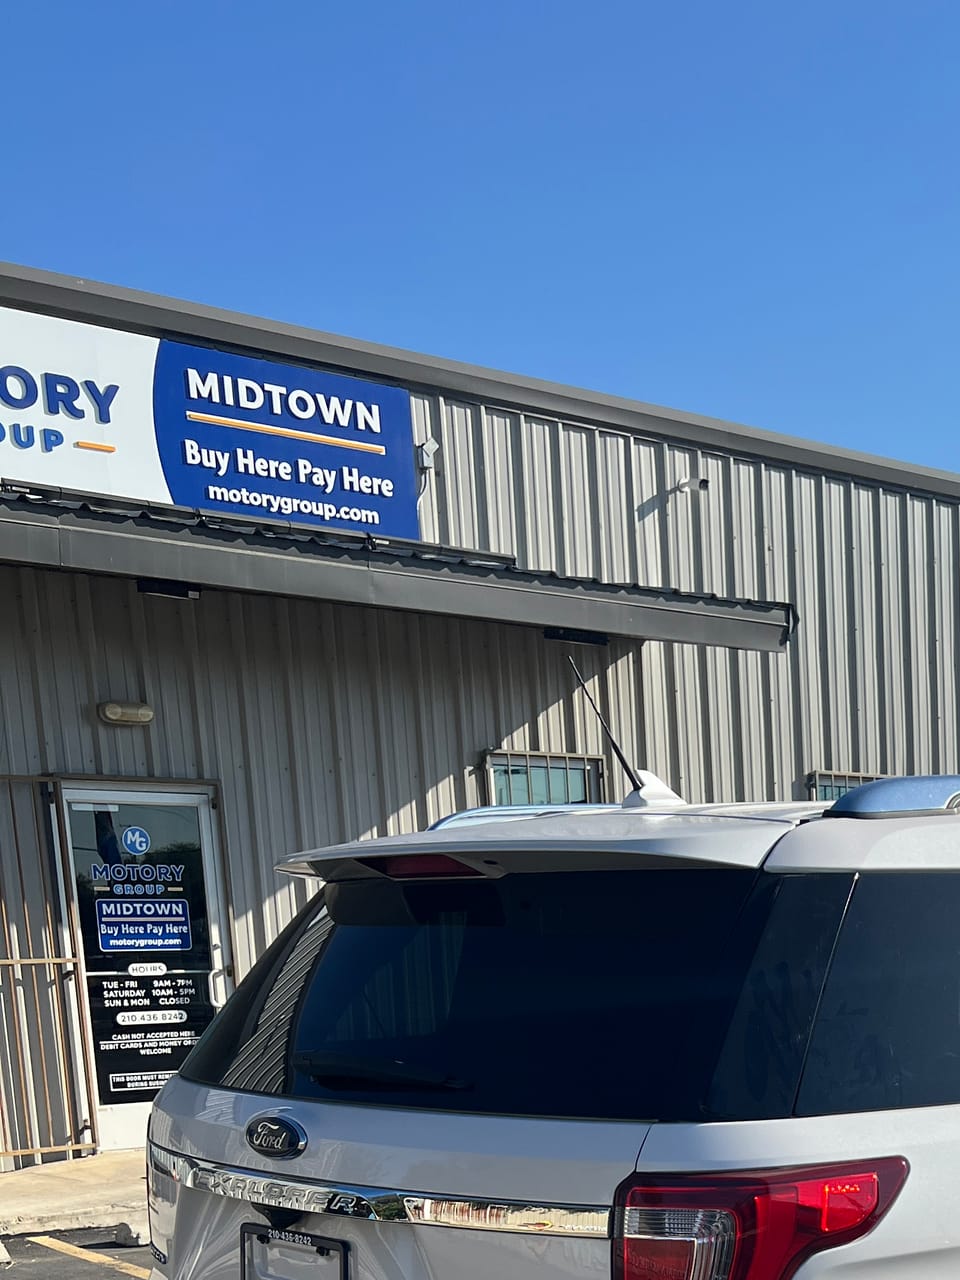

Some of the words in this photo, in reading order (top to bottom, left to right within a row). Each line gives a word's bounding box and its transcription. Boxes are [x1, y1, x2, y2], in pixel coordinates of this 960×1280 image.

[0, 365, 120, 424] ORY
[186, 368, 381, 433] MIDTOWN
[0, 422, 64, 453] UP
[184, 438, 229, 476] Buy
[236, 447, 292, 481] Here
[297, 458, 336, 494] Pay
[342, 466, 394, 497] Here
[207, 484, 380, 525] motorygroup.com
[91, 864, 184, 881] MOTORY
[113, 884, 165, 895] GROUP
[102, 903, 183, 915] MIDTOWN
[101, 924, 118, 936] Buy
[121, 924, 144, 933] Here
[146, 924, 163, 936] Pay
[166, 924, 188, 933] Here
[109, 938, 182, 947] motorygroup.com
[131, 966, 164, 974] HOURS
[102, 981, 119, 989] TUE
[125, 980, 138, 988] FRI
[103, 989, 146, 998] SATURDAY
[152, 988, 173, 996] 10AM
[104, 999, 121, 1007] SUN
[130, 998, 150, 1006] MON
[159, 997, 190, 1005] CLOSED
[146, 1031, 179, 1039] ACCEPTED
[120, 1042, 142, 1050] CARDS
[140, 1047, 172, 1056] WELCOME
[253, 1121, 287, 1149] Ford
[195, 1168, 358, 1211] EXPLORER
